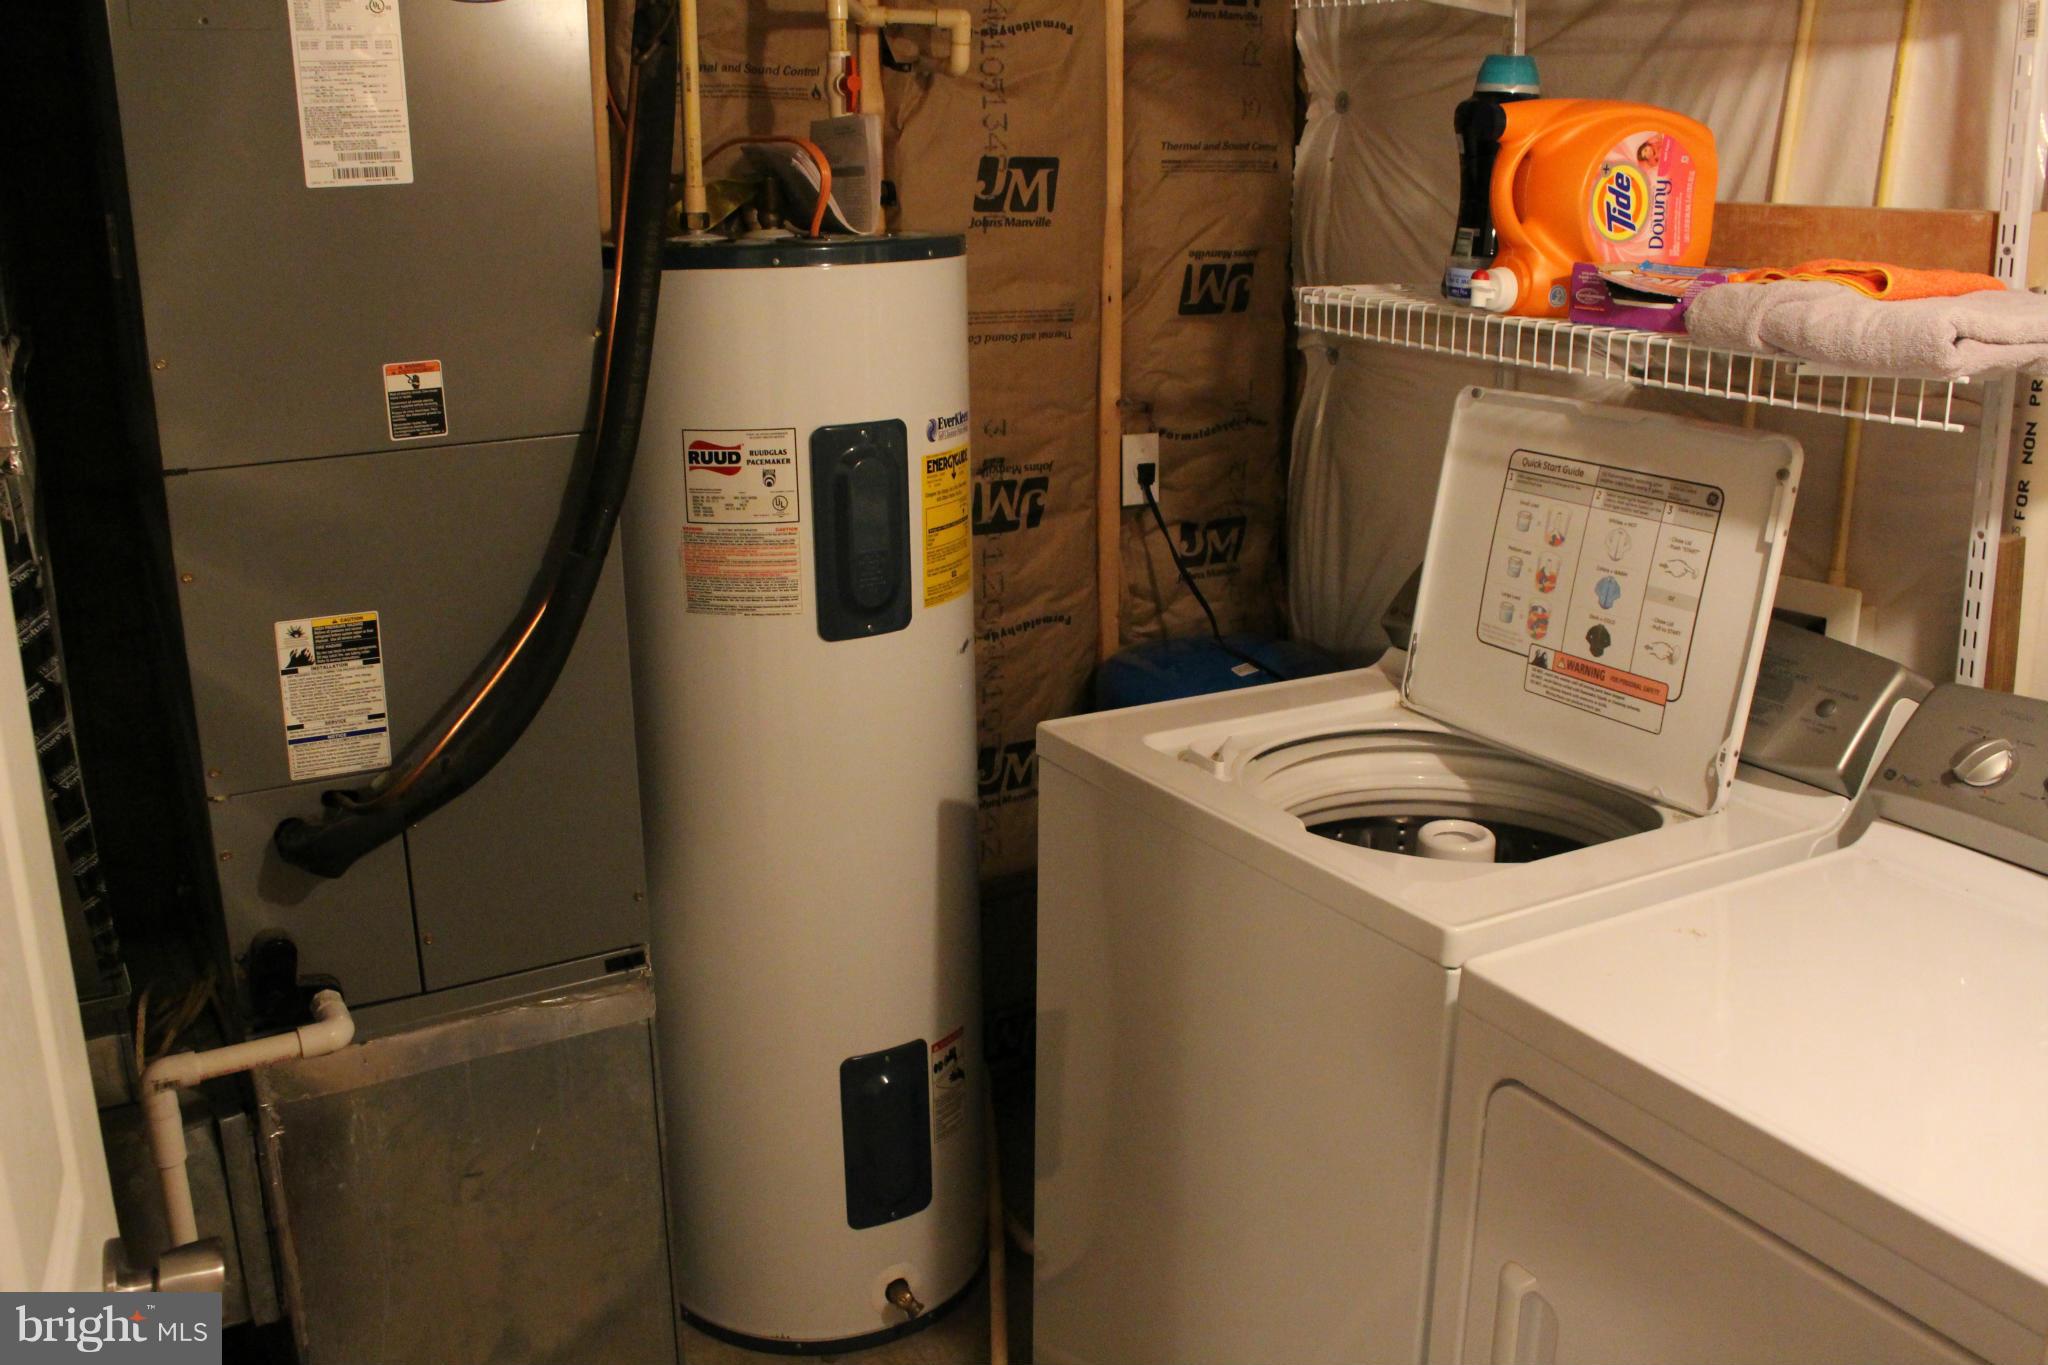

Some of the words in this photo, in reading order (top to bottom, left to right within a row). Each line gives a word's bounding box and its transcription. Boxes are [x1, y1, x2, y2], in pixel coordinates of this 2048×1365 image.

[721, 63, 742, 73] and
[743, 64, 780, 75] Sound
[783, 65, 821, 77] Control
[1606, 171, 1636, 232] Tide
[1004, 217, 1052, 229] Manville
[1648, 180, 1673, 249] Downy
[688, 450, 742, 465] RUUD
[746, 458, 791, 466] PACEMAKER
[749, 449, 788, 457] RUUDGLAS
[1521, 456, 1542, 468] Quick
[1542, 460, 1562, 473] Start
[1562, 464, 1585, 478] Guide
[2013, 479, 2031, 521] FOR
[2022, 421, 2038, 465] NON
[1566, 658, 1606, 682] WARNING
